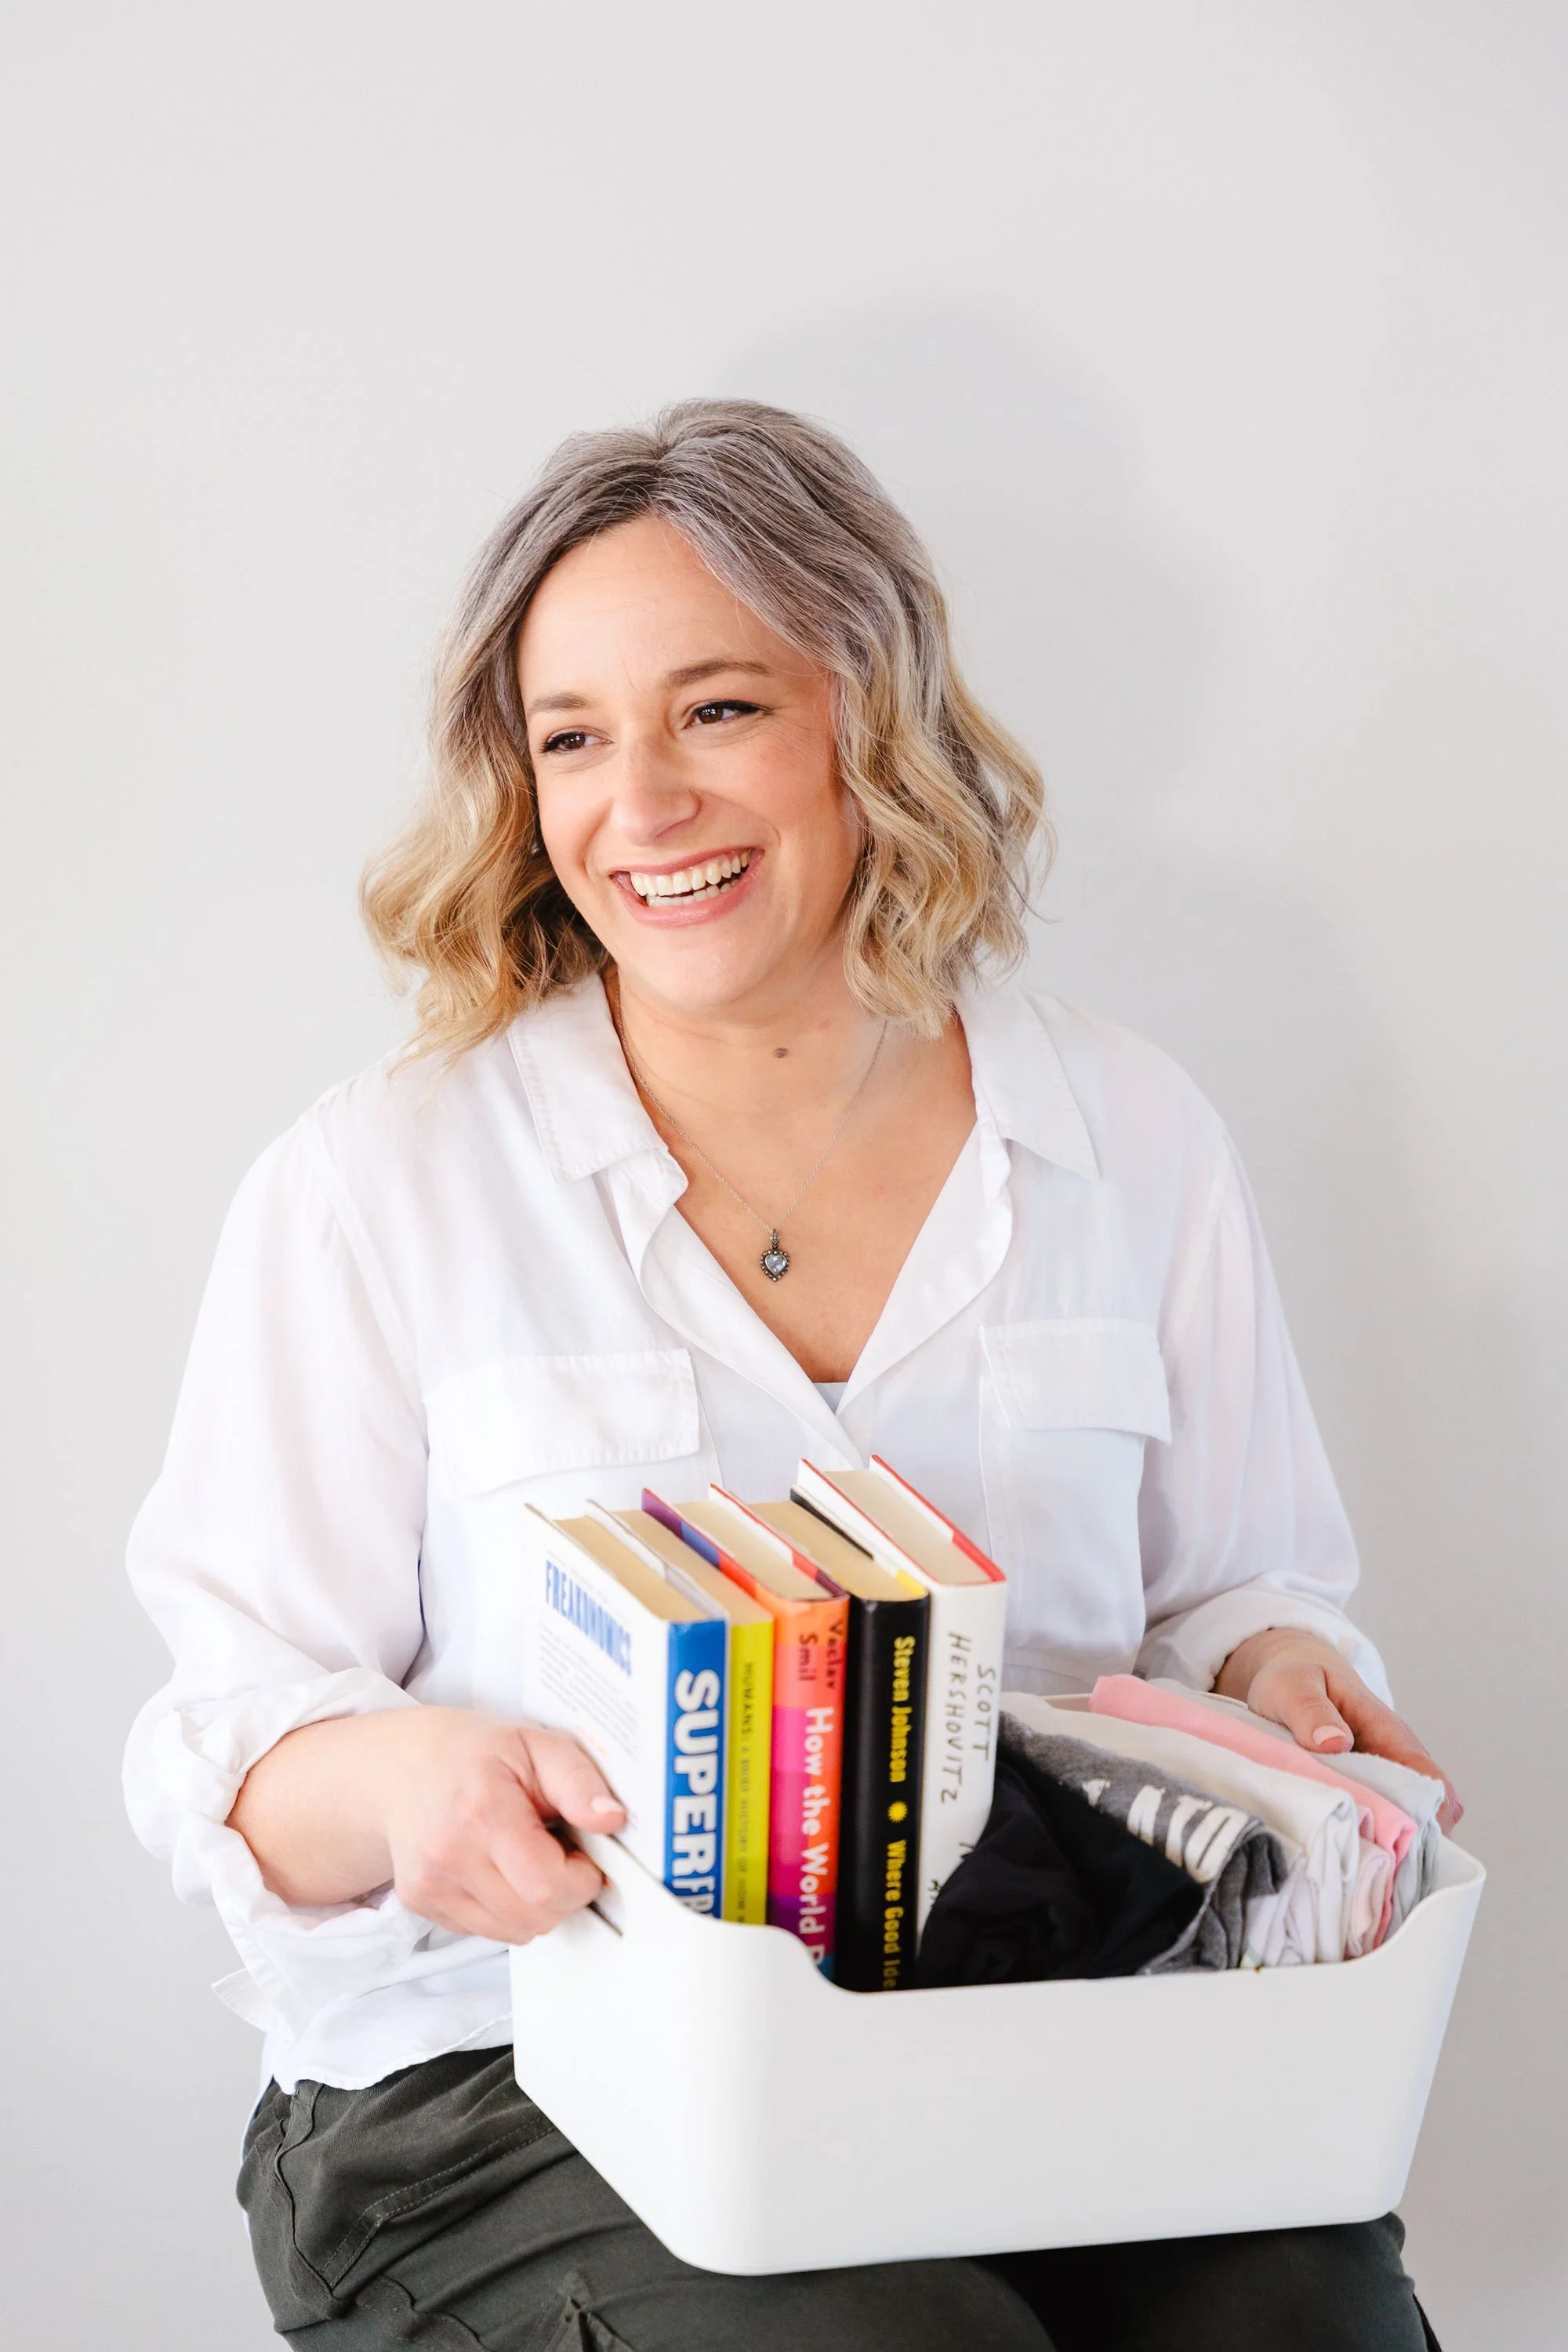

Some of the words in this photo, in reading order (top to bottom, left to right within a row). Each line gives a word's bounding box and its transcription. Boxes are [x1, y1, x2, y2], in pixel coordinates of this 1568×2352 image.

[546, 1559, 631, 1676] FREAKONOMICS
[798, 1632, 818, 1681] Smil
[826, 1621, 844, 1690] Vaclav
[892, 1635, 916, 1702] Steven
[804, 1706, 835, 1777] How
[889, 1706, 913, 1783] Johnson
[941, 1631, 973, 1803] HERSHOVITZ
[972, 1664, 996, 1762] SCOTT
[672, 1668, 720, 1915] SUPERFR
[801, 1784, 831, 1836] the
[799, 1842, 829, 1935] World
[884, 1839, 907, 1902] Where
[884, 1906, 905, 1955] Good
